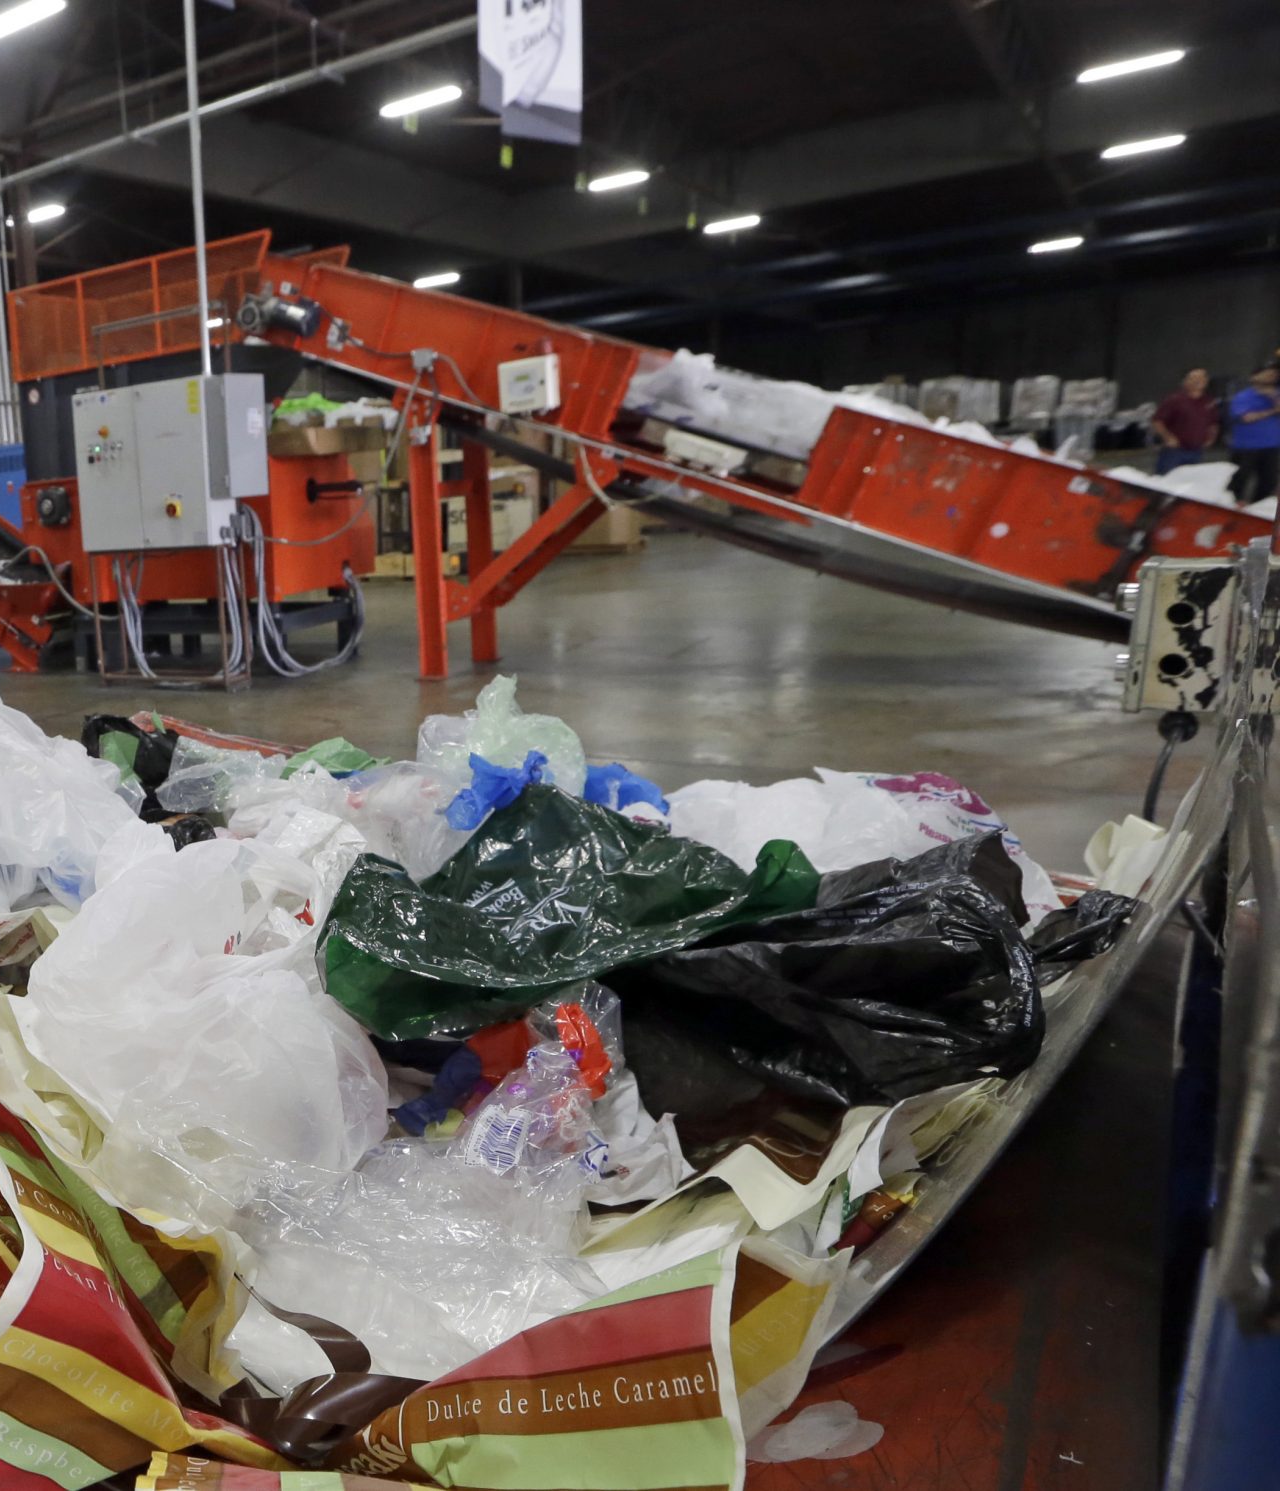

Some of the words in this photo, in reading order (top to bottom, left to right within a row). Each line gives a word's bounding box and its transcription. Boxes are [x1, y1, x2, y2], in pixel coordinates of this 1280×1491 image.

[3, 1338, 135, 1413] Chocolate
[426, 1393, 482, 1423] Dulce
[497, 1389, 529, 1415] de
[540, 1381, 602, 1413] Leche
[613, 1361, 718, 1405] Caramel
